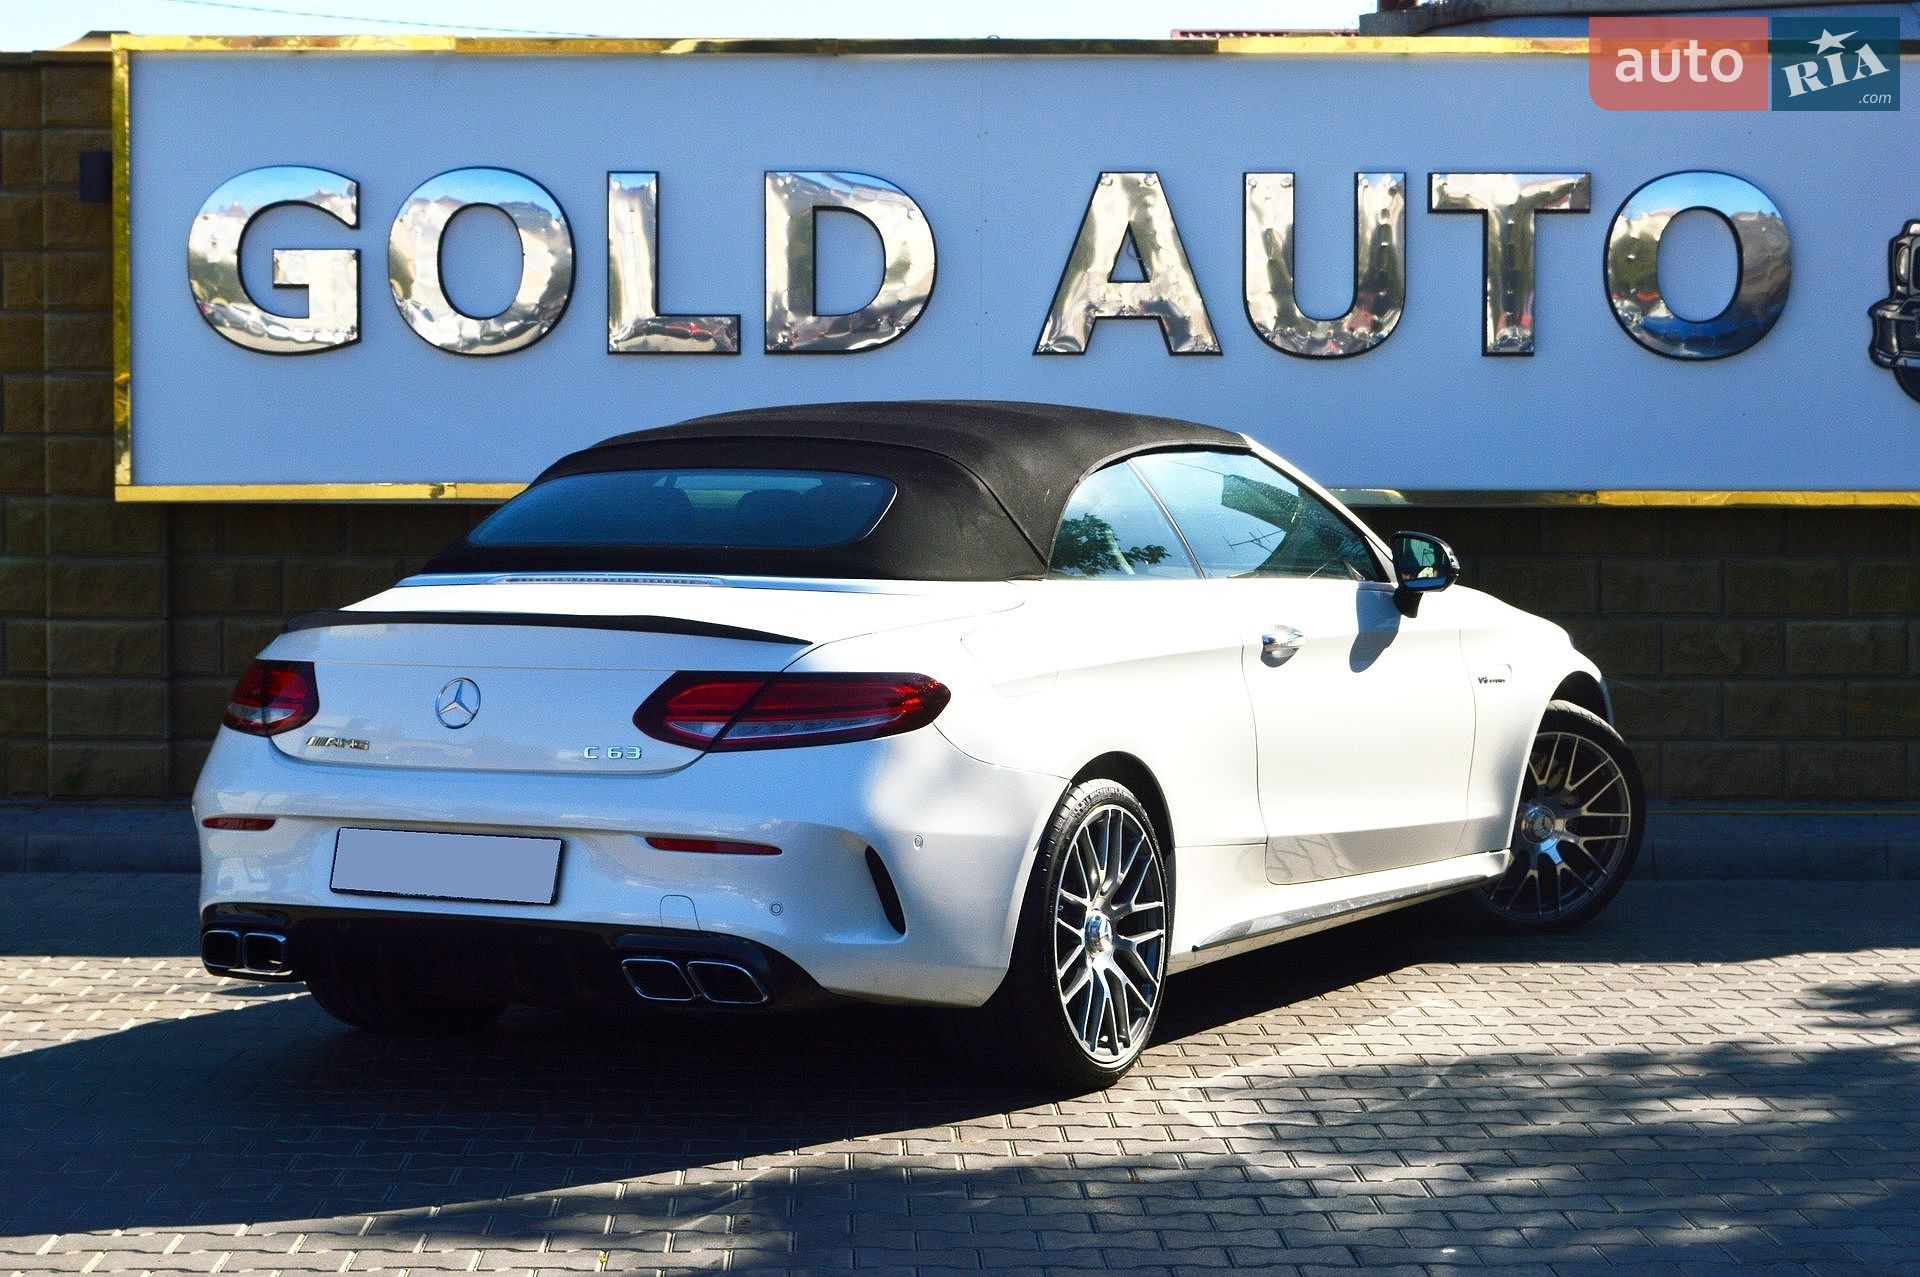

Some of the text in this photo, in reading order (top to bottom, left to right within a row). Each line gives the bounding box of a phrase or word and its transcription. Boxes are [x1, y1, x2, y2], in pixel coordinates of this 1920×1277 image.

[187, 165, 1795, 361] GOLD AUTO
[584, 745, 641, 759] C 63
